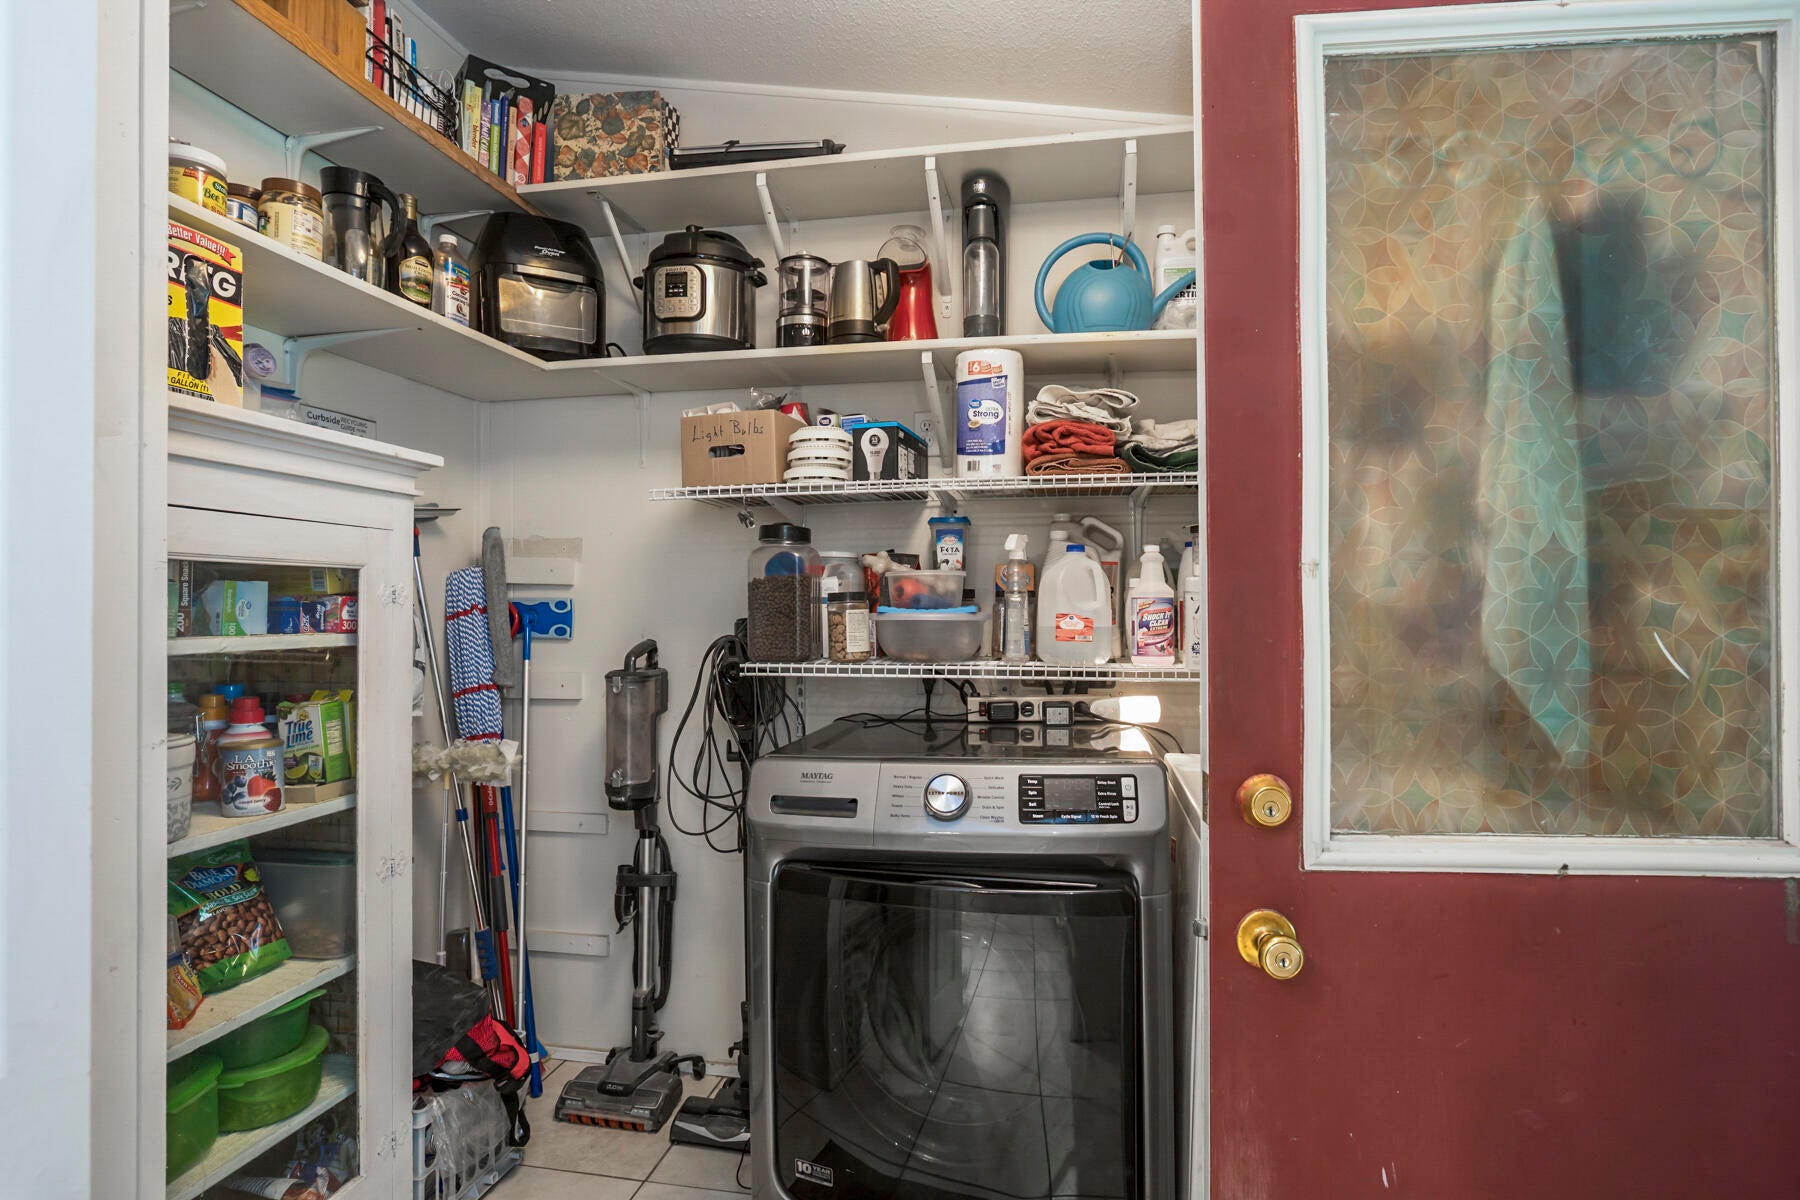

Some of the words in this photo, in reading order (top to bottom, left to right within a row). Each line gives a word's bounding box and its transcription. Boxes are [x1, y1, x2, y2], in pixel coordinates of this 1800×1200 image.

[203, 186, 220, 202] Bee
[168, 224, 193, 241] Better
[195, 232, 226, 256] Value!!!
[972, 361, 980, 373] 6
[170, 376, 200, 390] GALLON
[306, 411, 340, 426] Curbside
[972, 410, 999, 420] Strong
[692, 424, 724, 442] Light
[729, 418, 765, 436] Bulbs
[181, 582, 190, 607] Square
[342, 620, 357, 630] 300
[285, 720, 312, 735] True
[286, 730, 313, 749] Lime
[801, 772, 833, 780] MAYTAG
[183, 866, 238, 889] DIAMOND
[189, 868, 219, 882] BLUE
[206, 883, 242, 900] BOLD
[797, 1161, 811, 1174] 10
[813, 1165, 831, 1175] YEAR
